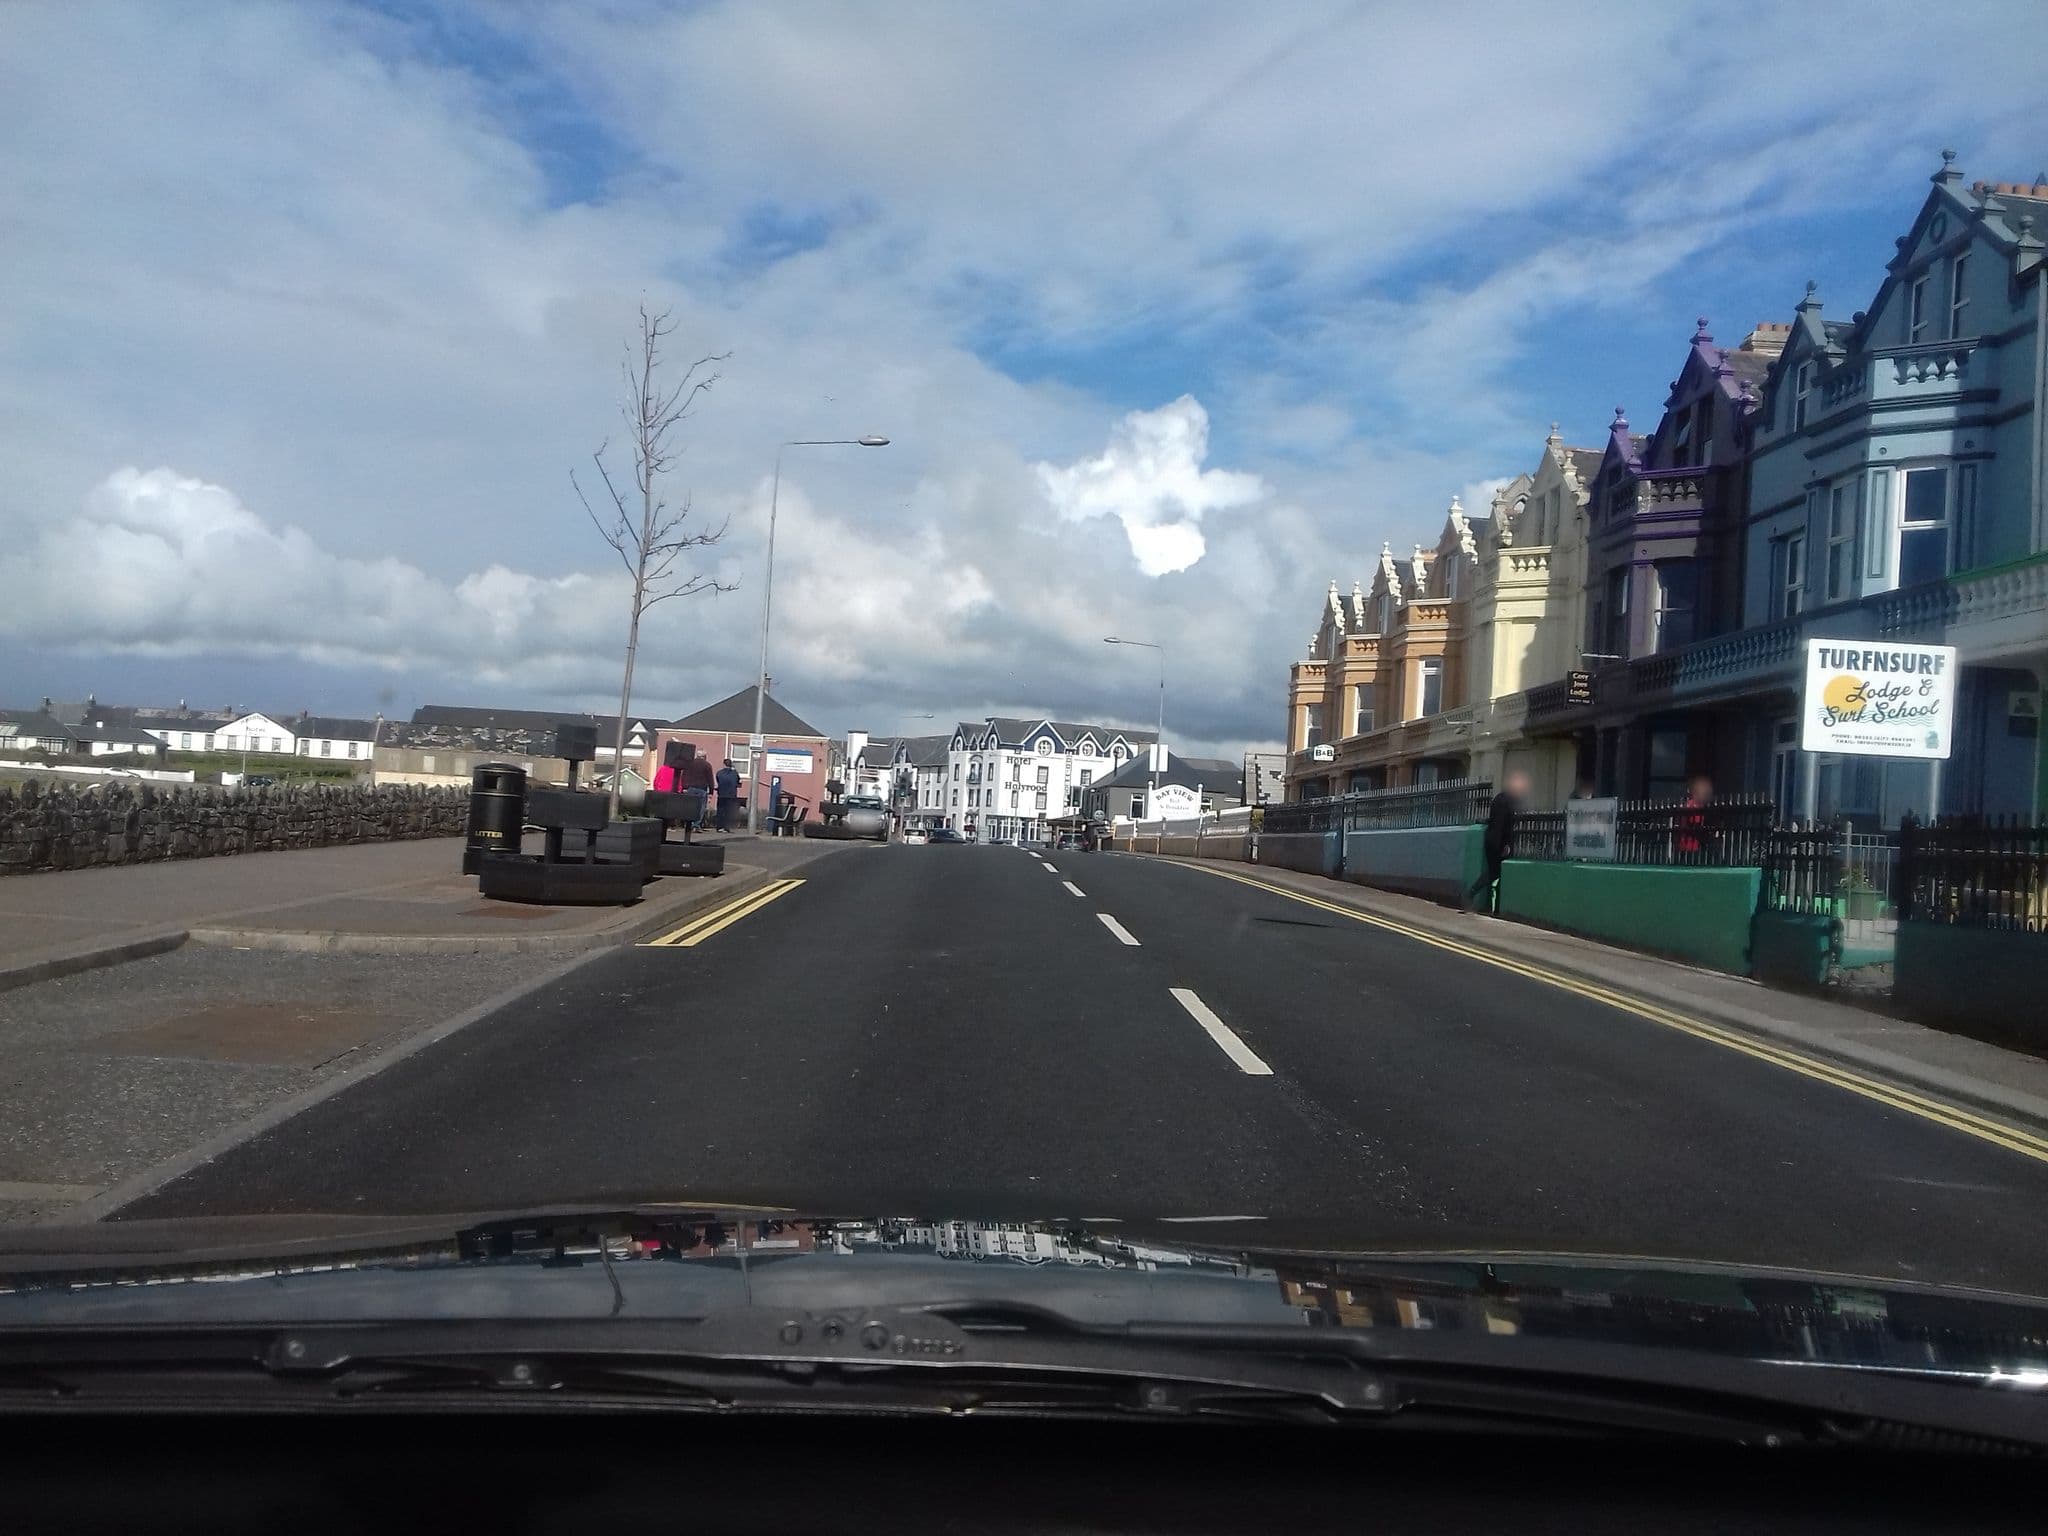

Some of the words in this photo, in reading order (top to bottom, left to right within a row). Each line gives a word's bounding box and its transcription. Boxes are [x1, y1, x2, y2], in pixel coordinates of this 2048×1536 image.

[1818, 648, 1946, 675] TURFNSURF
[1845, 681, 1913, 702] Lodge
[1919, 679, 1933, 696] &
[1822, 704, 1868, 727] Surf
[1872, 699, 1940, 723] School
[1006, 756, 1031, 765] Hotel
[1005, 782, 1047, 792] Holyrood
[1155, 790, 1170, 800] BAY
[1174, 789, 1194, 801] VIEW
[474, 830, 503, 838] LITTER
